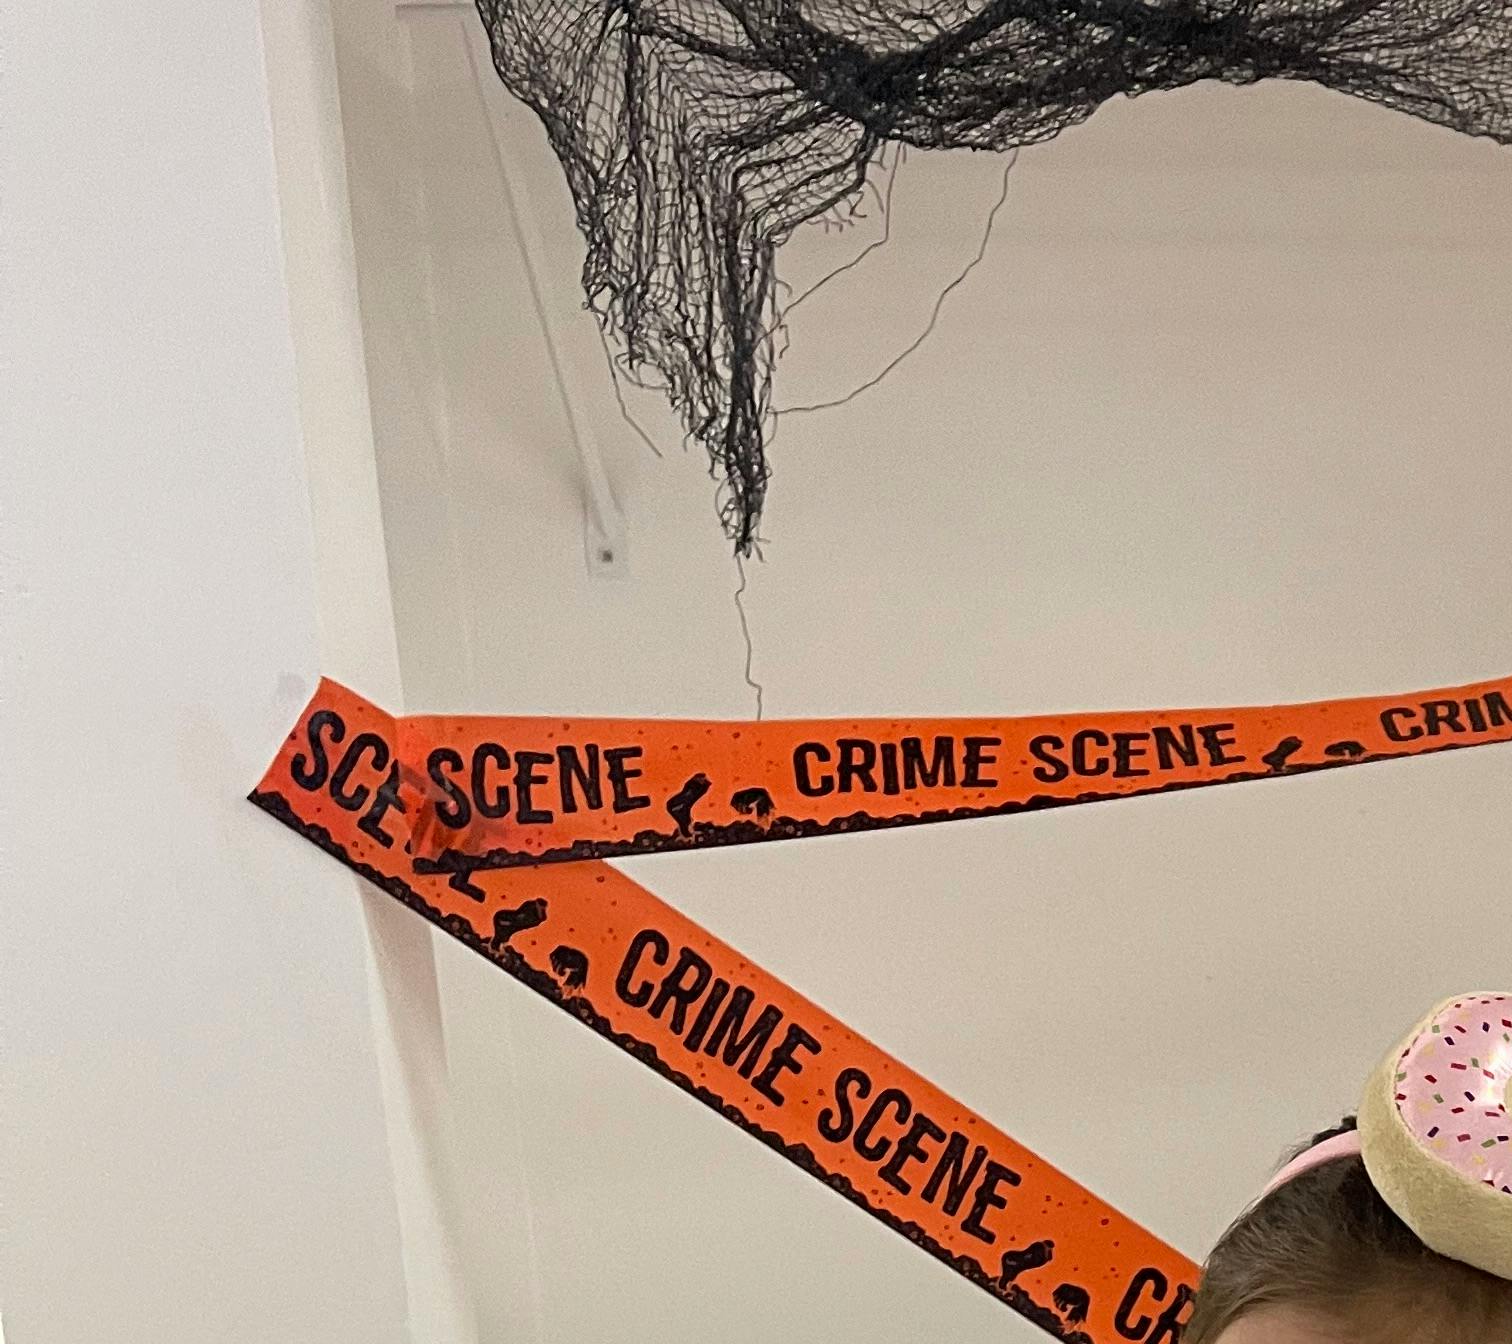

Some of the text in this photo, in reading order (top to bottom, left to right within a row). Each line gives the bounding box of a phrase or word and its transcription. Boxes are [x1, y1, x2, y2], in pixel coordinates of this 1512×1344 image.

[427, 741, 652, 830] SCENE
[792, 736, 1003, 797] CRIME
[1029, 722, 1244, 784] SCENE
[614, 928, 821, 1106] CRIME
[816, 1067, 1021, 1245] SCENE
